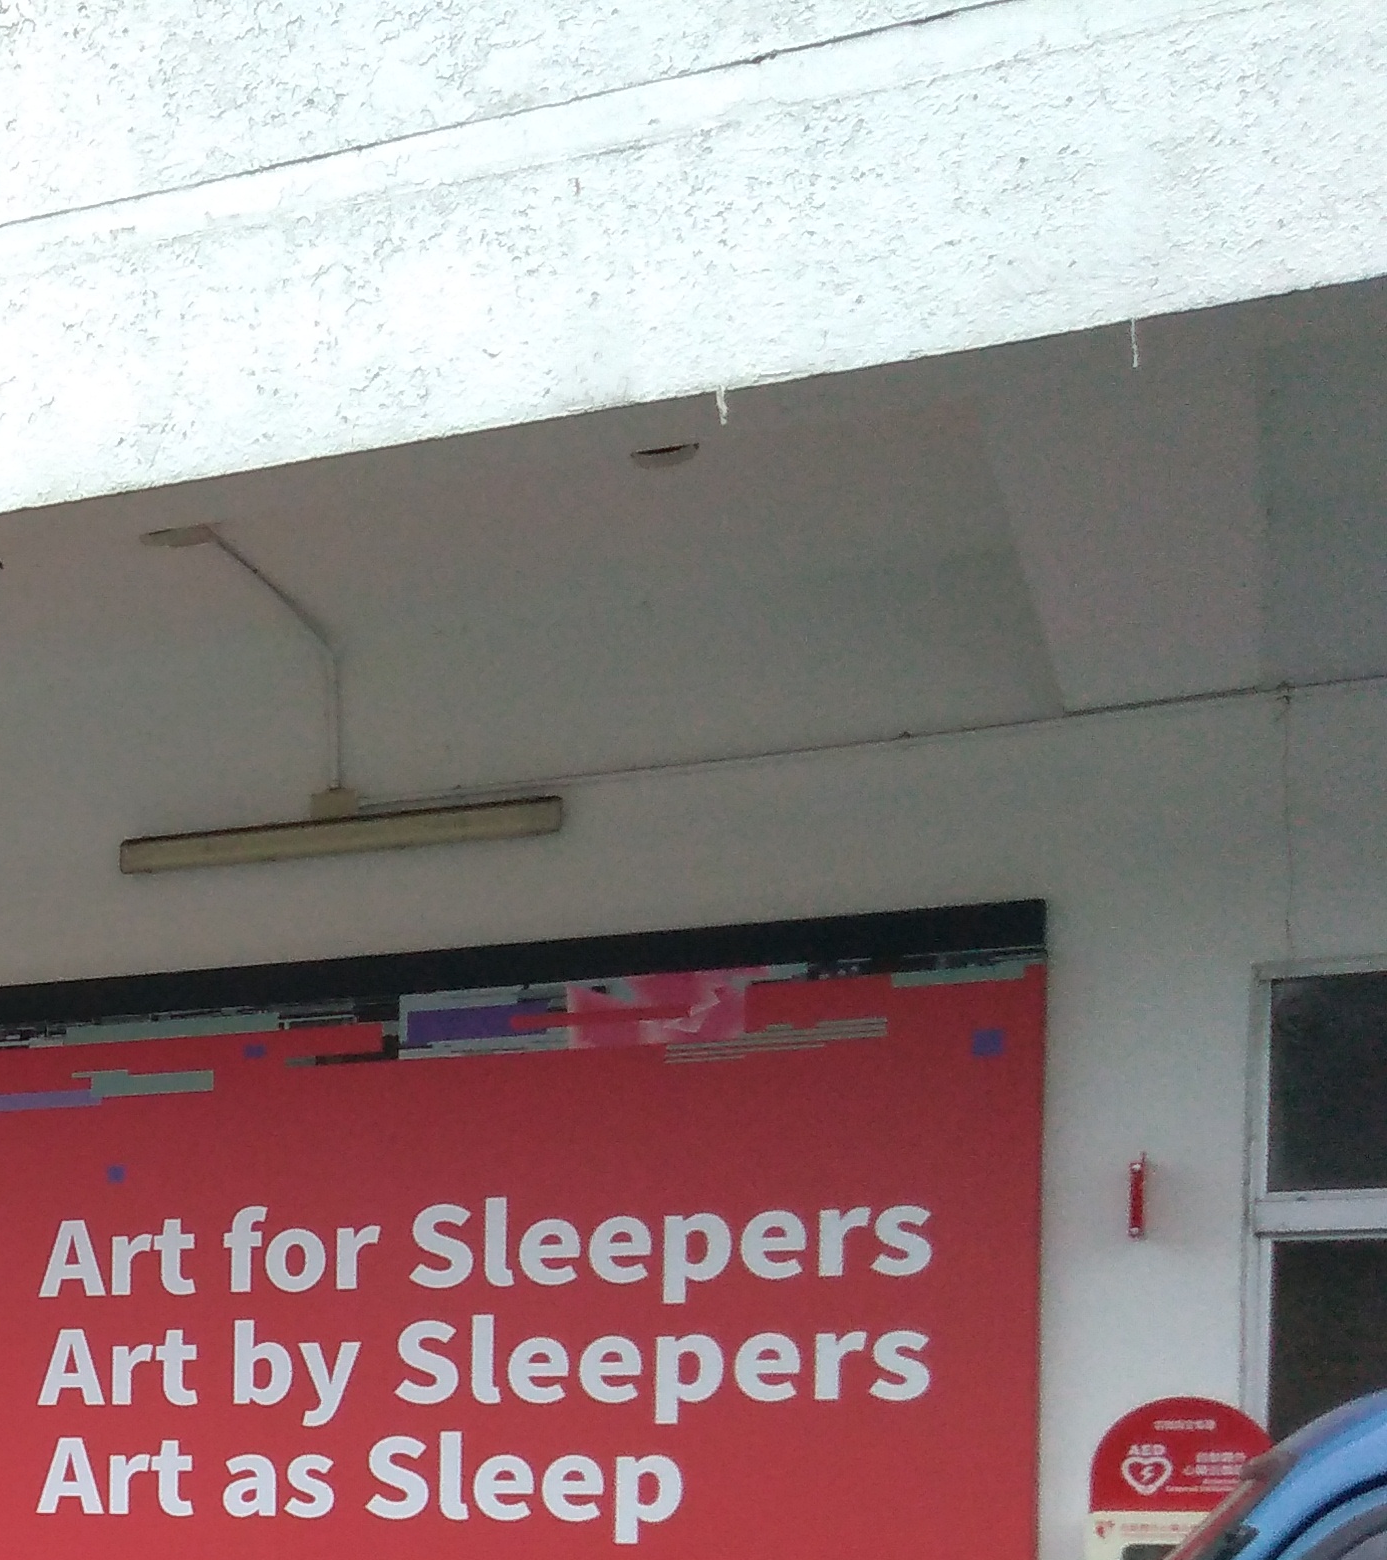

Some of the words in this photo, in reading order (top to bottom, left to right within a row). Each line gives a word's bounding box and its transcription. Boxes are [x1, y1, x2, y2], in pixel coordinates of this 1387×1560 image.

[39, 1218, 196, 1297] Art
[225, 1206, 381, 1293] for
[410, 1196, 934, 1304] Sleepers
[37, 1328, 198, 1406] Art
[233, 1319, 361, 1427] by
[394, 1314, 932, 1424] Sleepers
[37, 1436, 193, 1515] Art
[224, 1451, 335, 1518] as
[366, 1430, 684, 1544] Sleep
